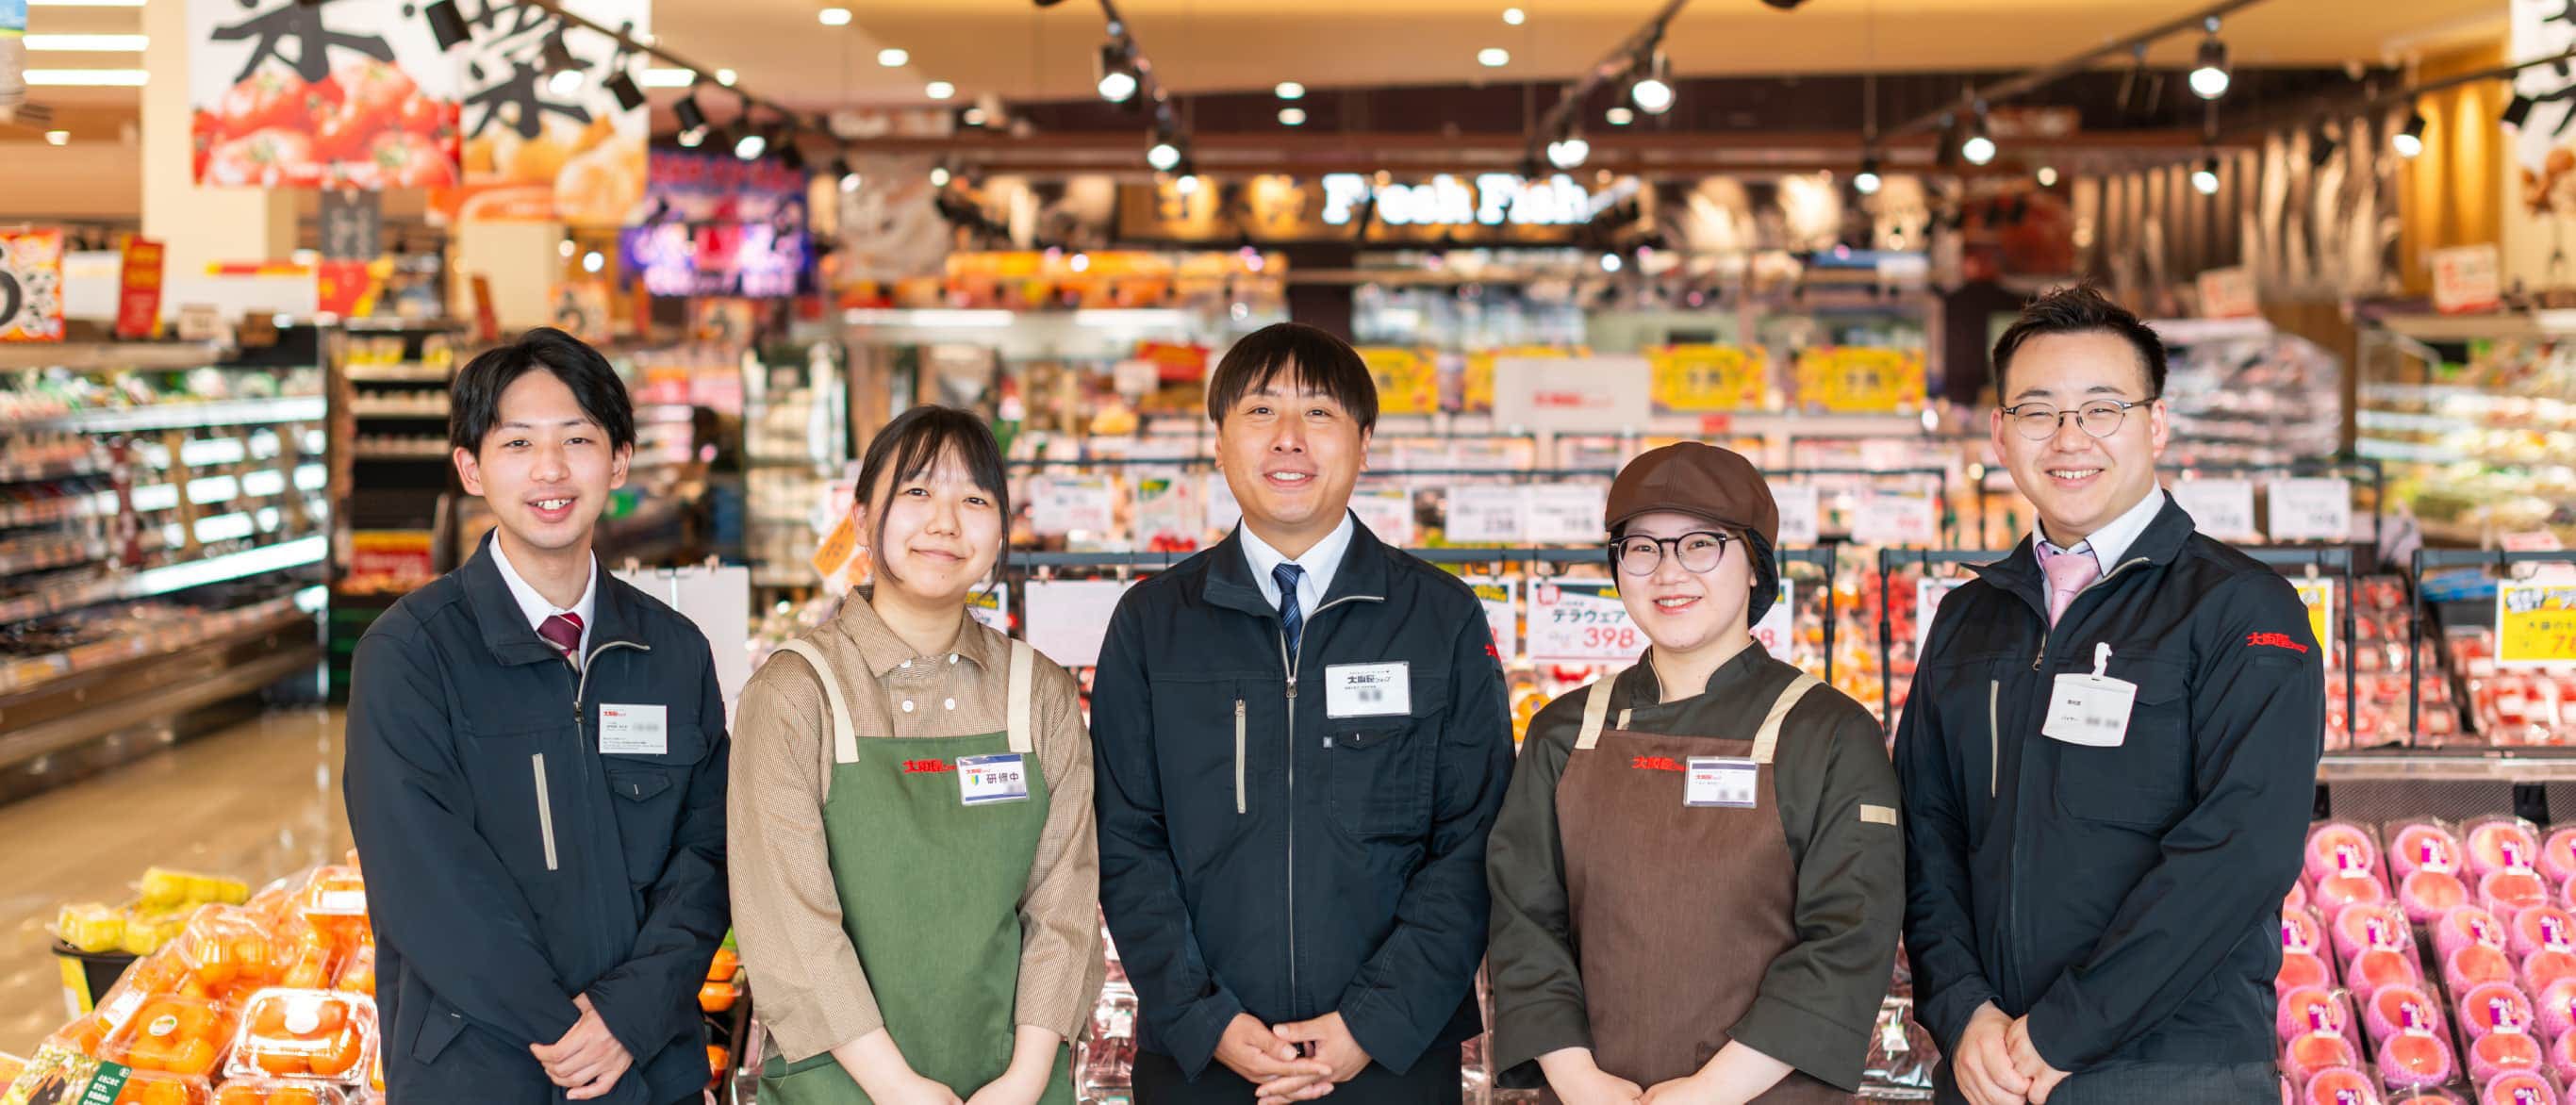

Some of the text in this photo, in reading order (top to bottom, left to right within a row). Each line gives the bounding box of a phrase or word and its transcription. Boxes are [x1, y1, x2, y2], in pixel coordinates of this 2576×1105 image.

[1552, 609, 1626, 623] テラウェア
[1583, 626, 1635, 649] 398
[986, 771, 1019, 784] 研修中
